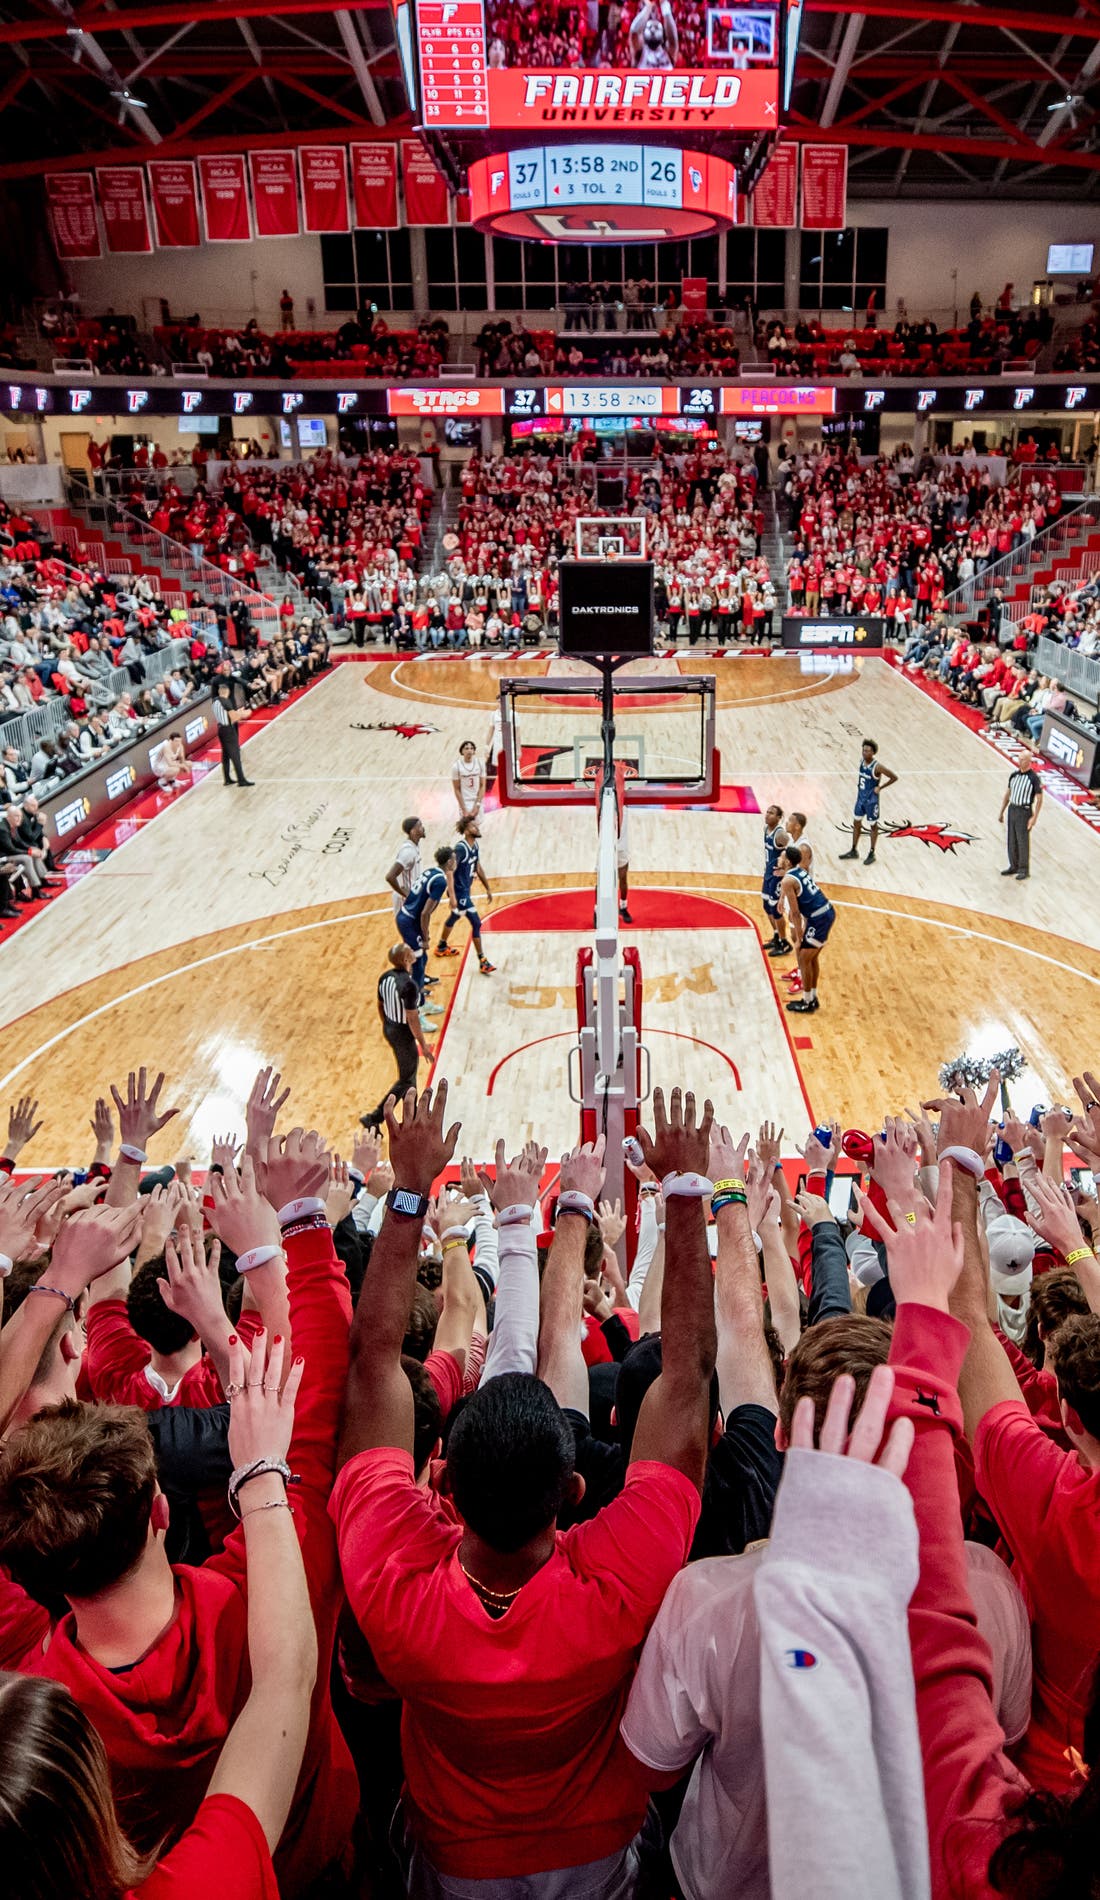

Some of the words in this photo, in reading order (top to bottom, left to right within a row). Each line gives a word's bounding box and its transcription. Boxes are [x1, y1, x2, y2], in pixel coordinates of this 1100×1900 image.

[425, 43, 433, 54] 0
[451, 43, 459, 54] 6
[471, 43, 479, 53] 0
[427, 59, 433, 69] 1
[452, 59, 460, 69] 4
[471, 59, 480, 70] 0
[472, 74, 481, 85] 0
[426, 89, 438, 100] 10
[474, 89, 481, 101] 2
[523, 75, 741, 108] FAIRFIELD
[455, 105, 462, 116] 2
[541, 108, 716, 121] UNIVERSITY
[361, 156, 387, 164] NCAA
[412, 152, 432, 160] NCA
[551, 157, 604, 174] 13:58
[611, 160, 638, 172] 2ND
[516, 163, 538, 184] 37
[651, 162, 676, 182] 26
[533, 188, 541, 198] 0
[568, 184, 574, 194] 3
[583, 183, 606, 194] TOL
[615, 184, 622, 194] 2
[672, 189, 677, 198] 3
[412, 390, 480, 406] STAGS
[514, 389, 536, 406] 37
[568, 393, 621, 407] 13:58
[628, 394, 657, 406] 2ND
[690, 389, 712, 406] 26
[741, 389, 816, 405] PEACOCKS
[571, 606, 639, 615] DAKTRONICS
[469, 778, 474, 787] 3
[860, 777, 865, 790] 5
[321, 827, 356, 855] COURT
